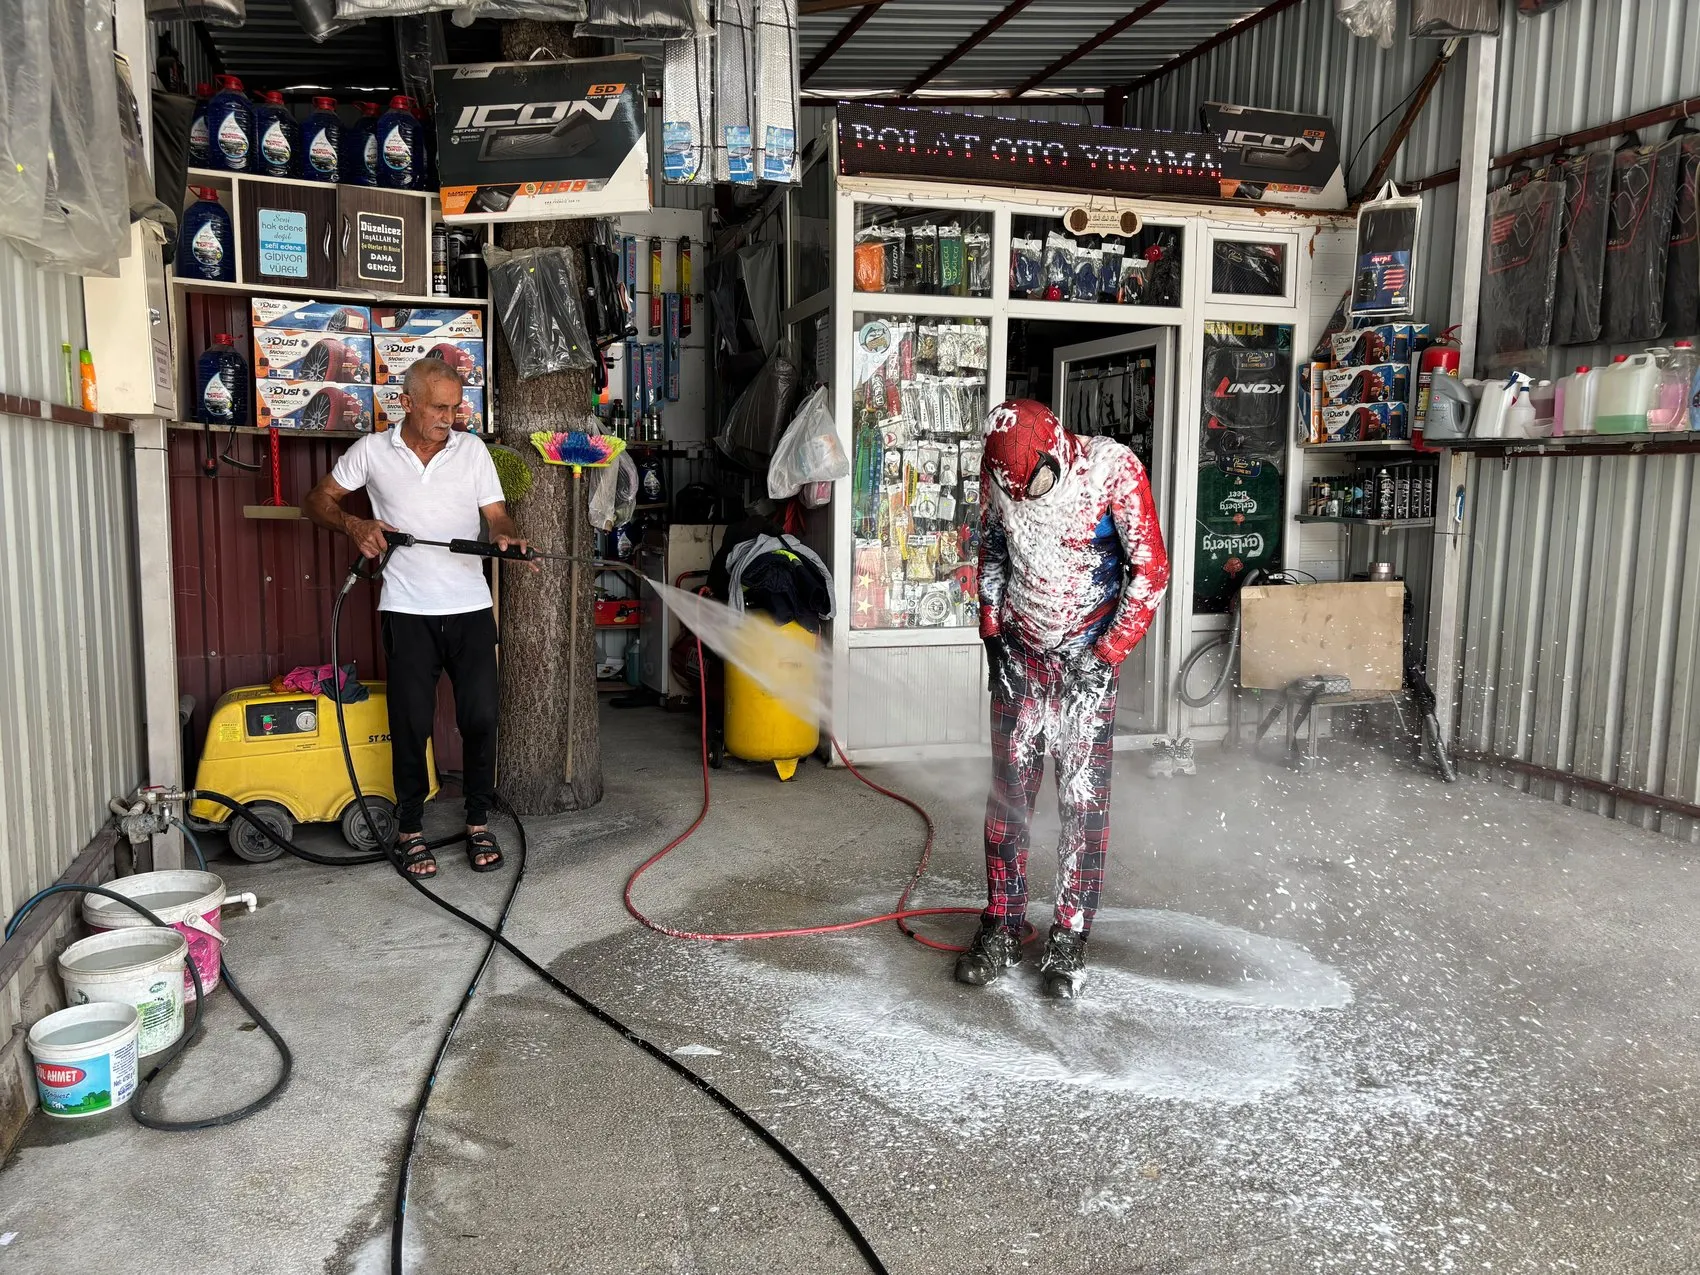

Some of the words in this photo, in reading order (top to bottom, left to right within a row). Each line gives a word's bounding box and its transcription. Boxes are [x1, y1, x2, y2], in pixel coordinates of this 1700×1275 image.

[594, 85, 617, 94] 5D
[455, 98, 620, 129] ICON
[1223, 129, 1324, 153] ICON
[261, 222, 278, 231] hak
[280, 222, 304, 232] edene
[360, 220, 402, 236] Düzelicez
[264, 242, 279, 250] sefil
[264, 252, 303, 263] GİDİYOR
[370, 252, 394, 263] DAHA
[269, 263, 299, 275] YÜREK
[271, 336, 300, 347] Dust
[391, 343, 416, 353] Dust
[1332, 373, 1347, 382] Dust
[272, 385, 301, 396] Dust
[1227, 383, 1286, 394] KONI
[1219, 498, 1258, 514] Carlsberg
[1202, 532, 1265, 558] Carlsberg
[368, 734, 379, 743] ST
[47, 1069, 78, 1083] AHMET
